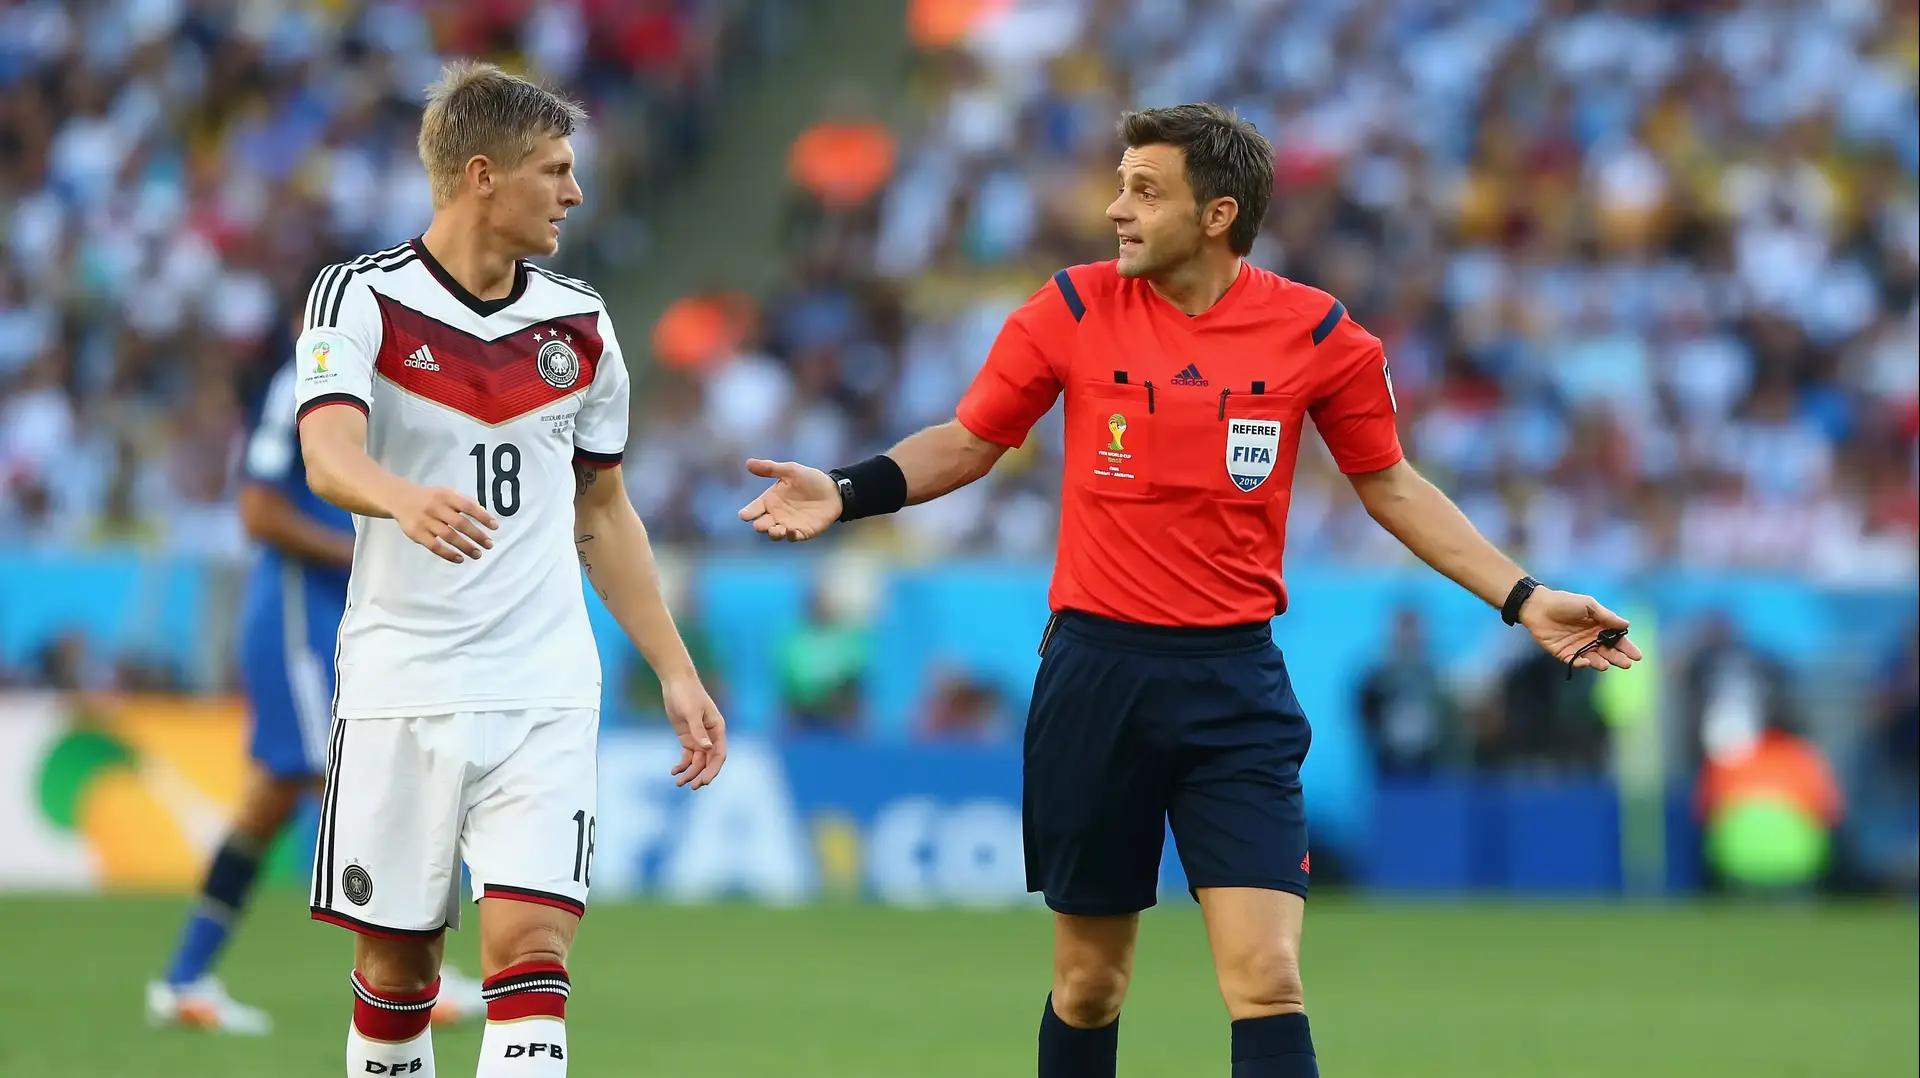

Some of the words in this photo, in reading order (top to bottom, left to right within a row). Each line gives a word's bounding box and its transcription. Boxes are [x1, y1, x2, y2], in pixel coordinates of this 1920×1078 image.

[404, 358, 441, 372] adidas
[1171, 378, 1209, 386] adidas
[1232, 424, 1277, 436] REFEREE
[1232, 446, 1271, 464] FIFA
[469, 443, 521, 517] 18
[1239, 478, 1258, 486] 2014
[572, 809, 596, 889] 18
[504, 1042, 564, 1060] DFB
[364, 1057, 423, 1077] DFB
